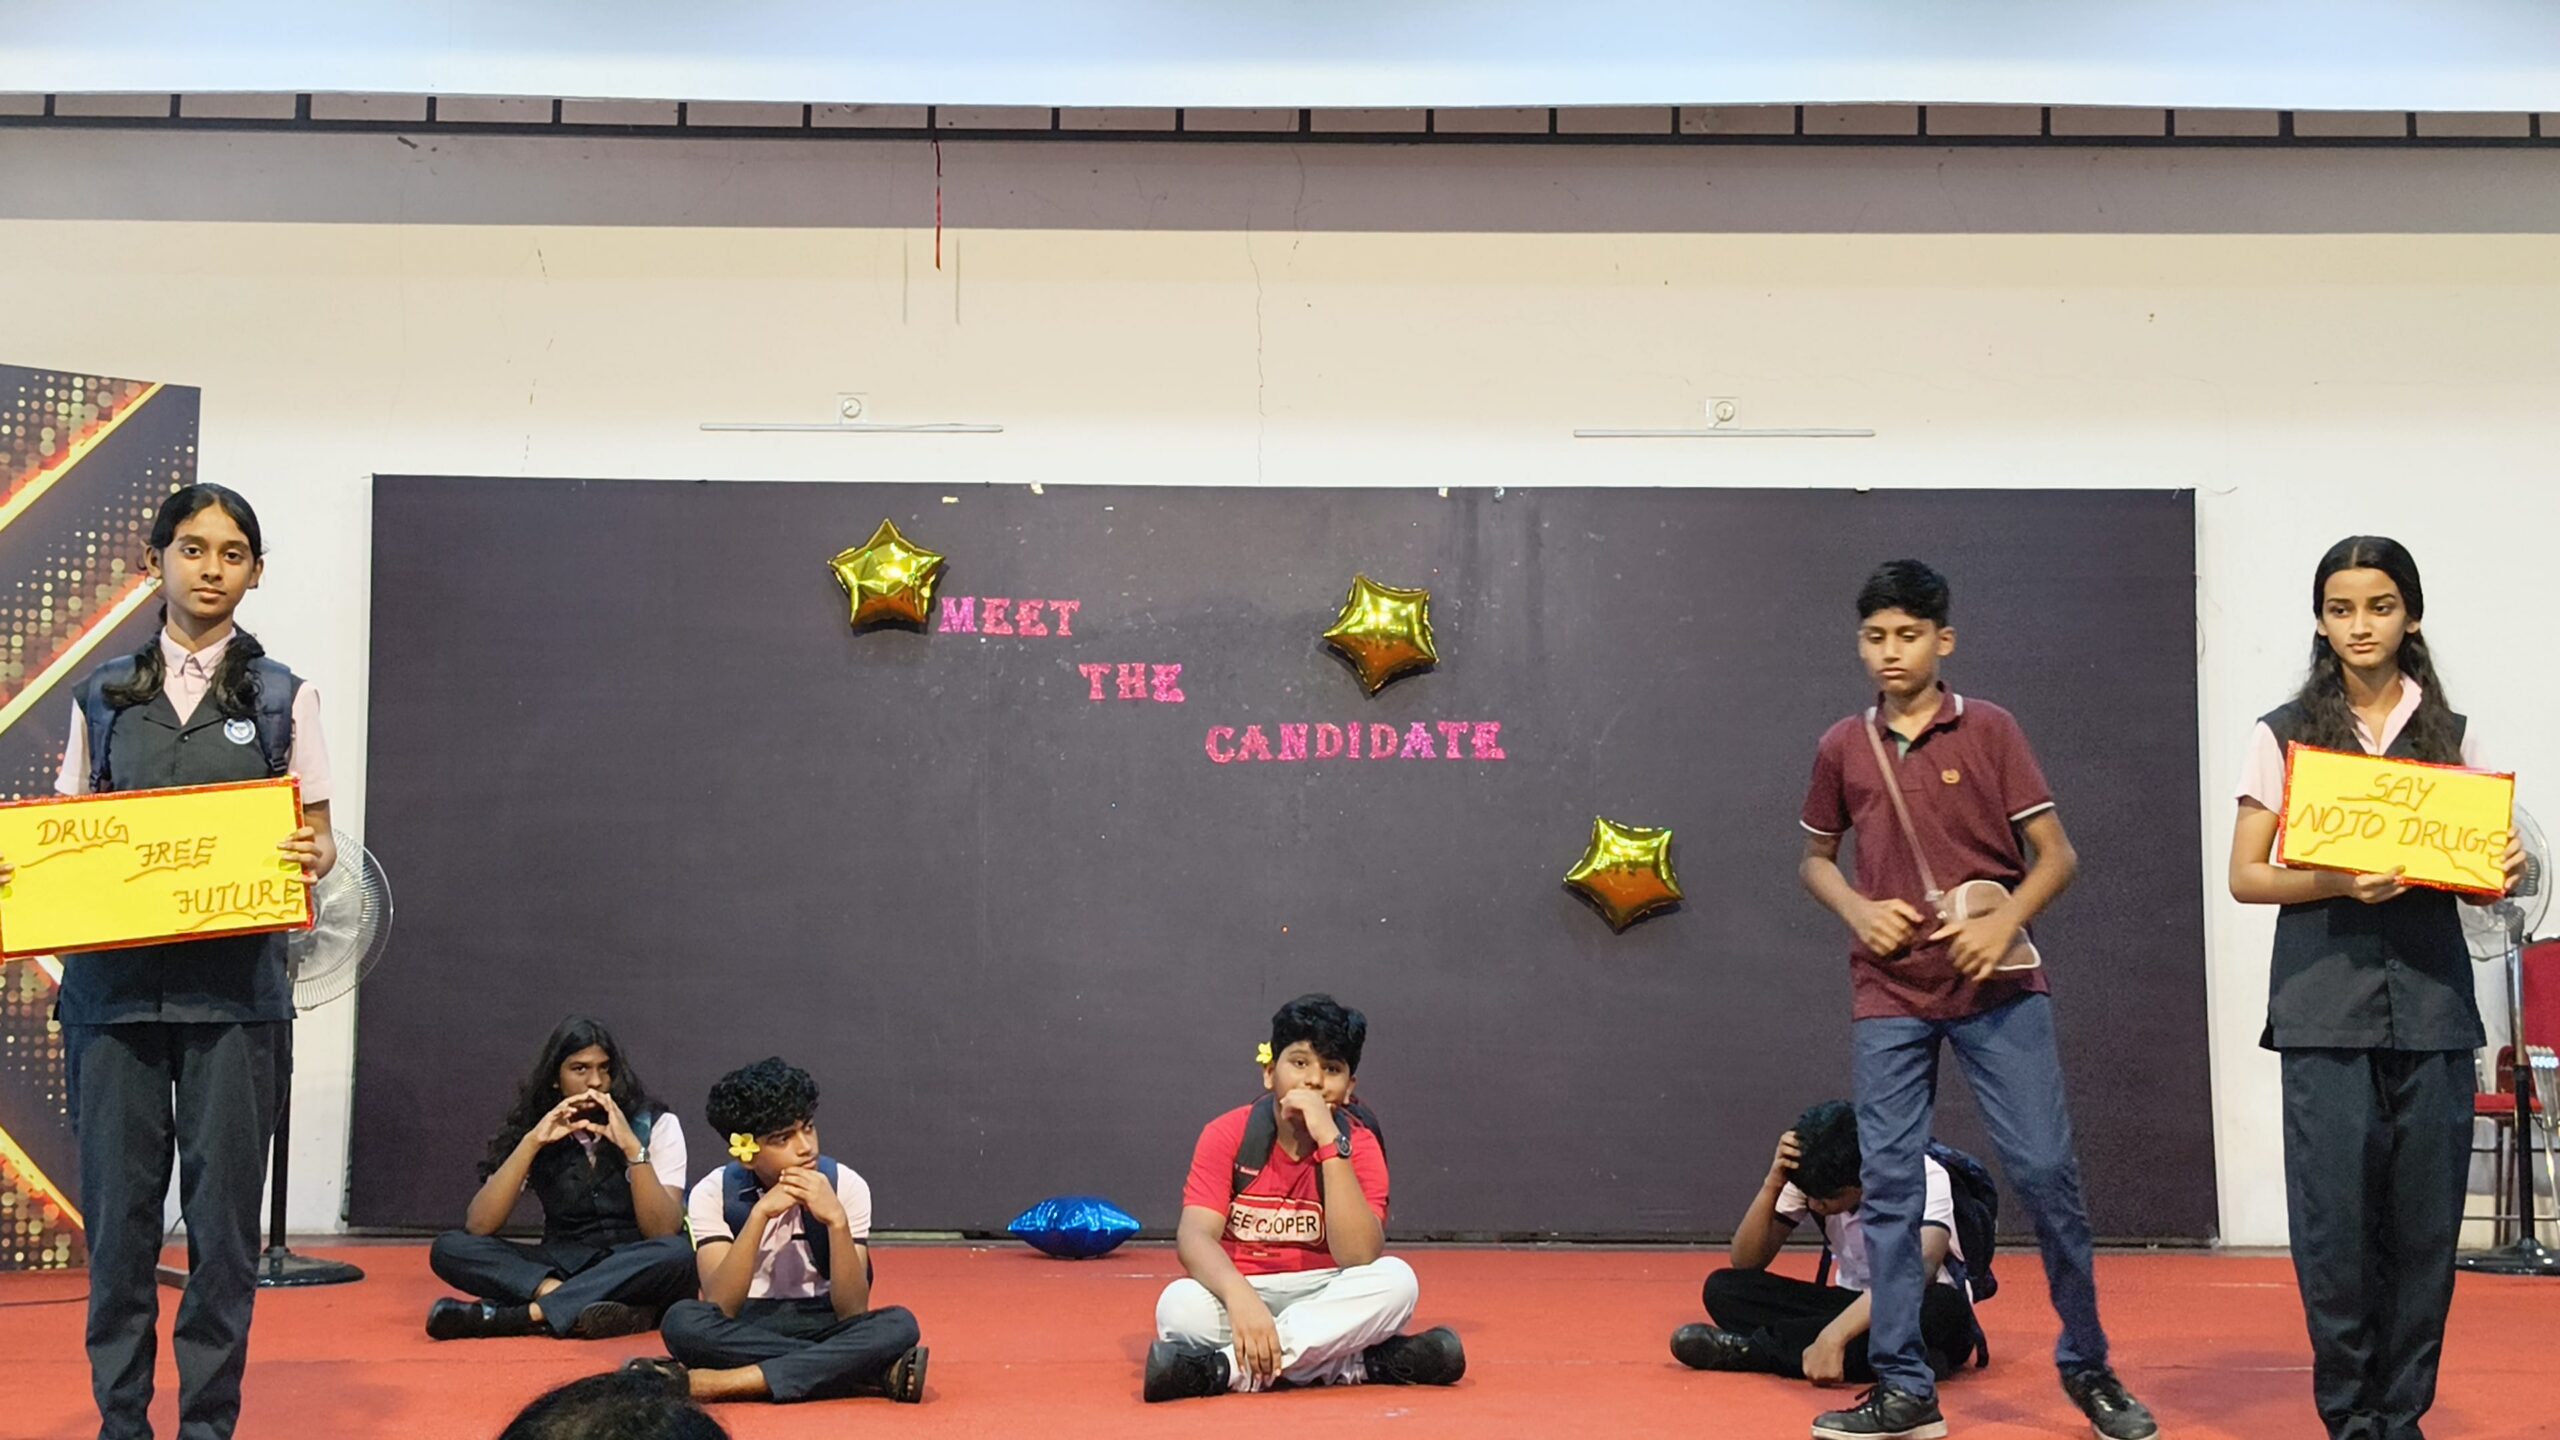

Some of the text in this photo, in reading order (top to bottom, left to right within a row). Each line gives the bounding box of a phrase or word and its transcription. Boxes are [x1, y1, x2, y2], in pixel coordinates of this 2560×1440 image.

[938, 597, 1080, 637] MEET
[1079, 663, 1185, 703] THE
[1205, 721, 1506, 764] CANDIDATE
[2366, 773, 2435, 810] SAY
[37, 816, 129, 846] DRUG
[2398, 817, 2508, 859] DRUGS
[136, 837, 217, 867] FREE
[173, 878, 303, 914] FUTURE
